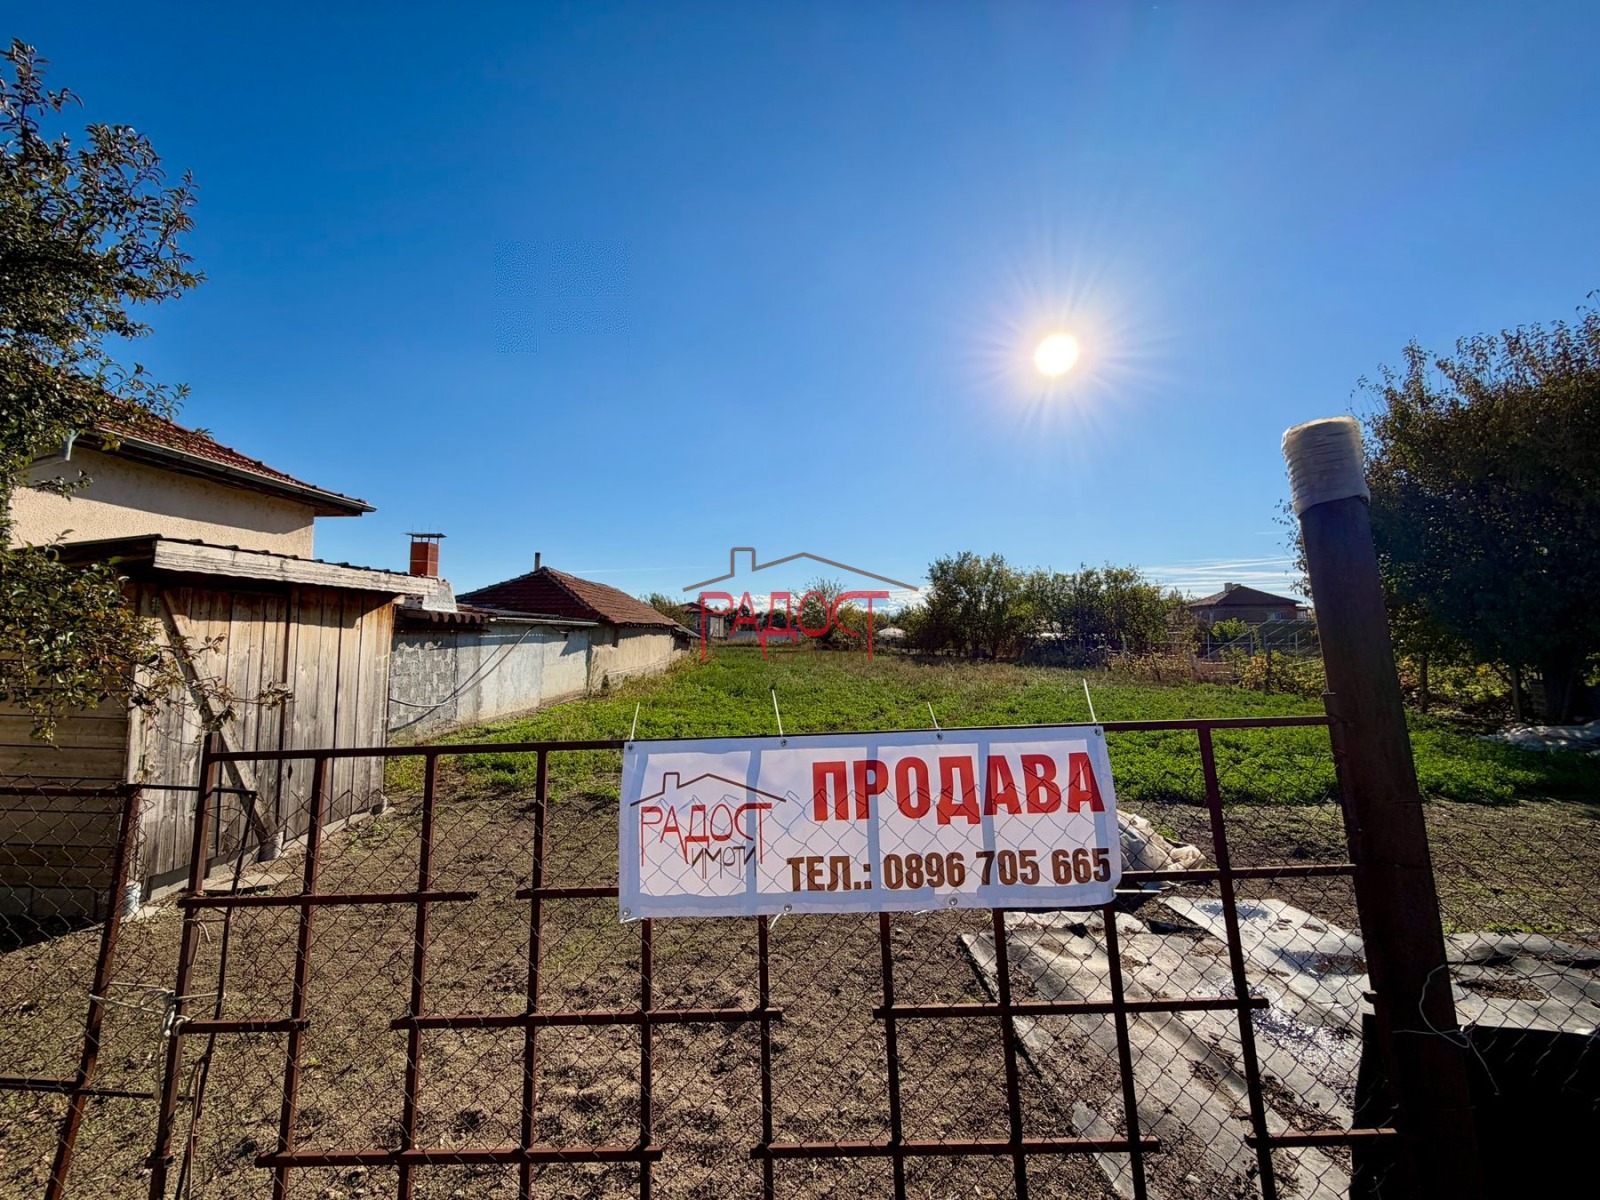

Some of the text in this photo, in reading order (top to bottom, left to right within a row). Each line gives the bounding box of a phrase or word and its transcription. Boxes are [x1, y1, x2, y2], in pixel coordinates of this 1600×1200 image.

[812, 752, 1105, 825] ПРОДАВА
[641, 803, 772, 867] РАДОСТ
[787, 847, 1110, 892] ТЕЛ.: 0896 705 665
